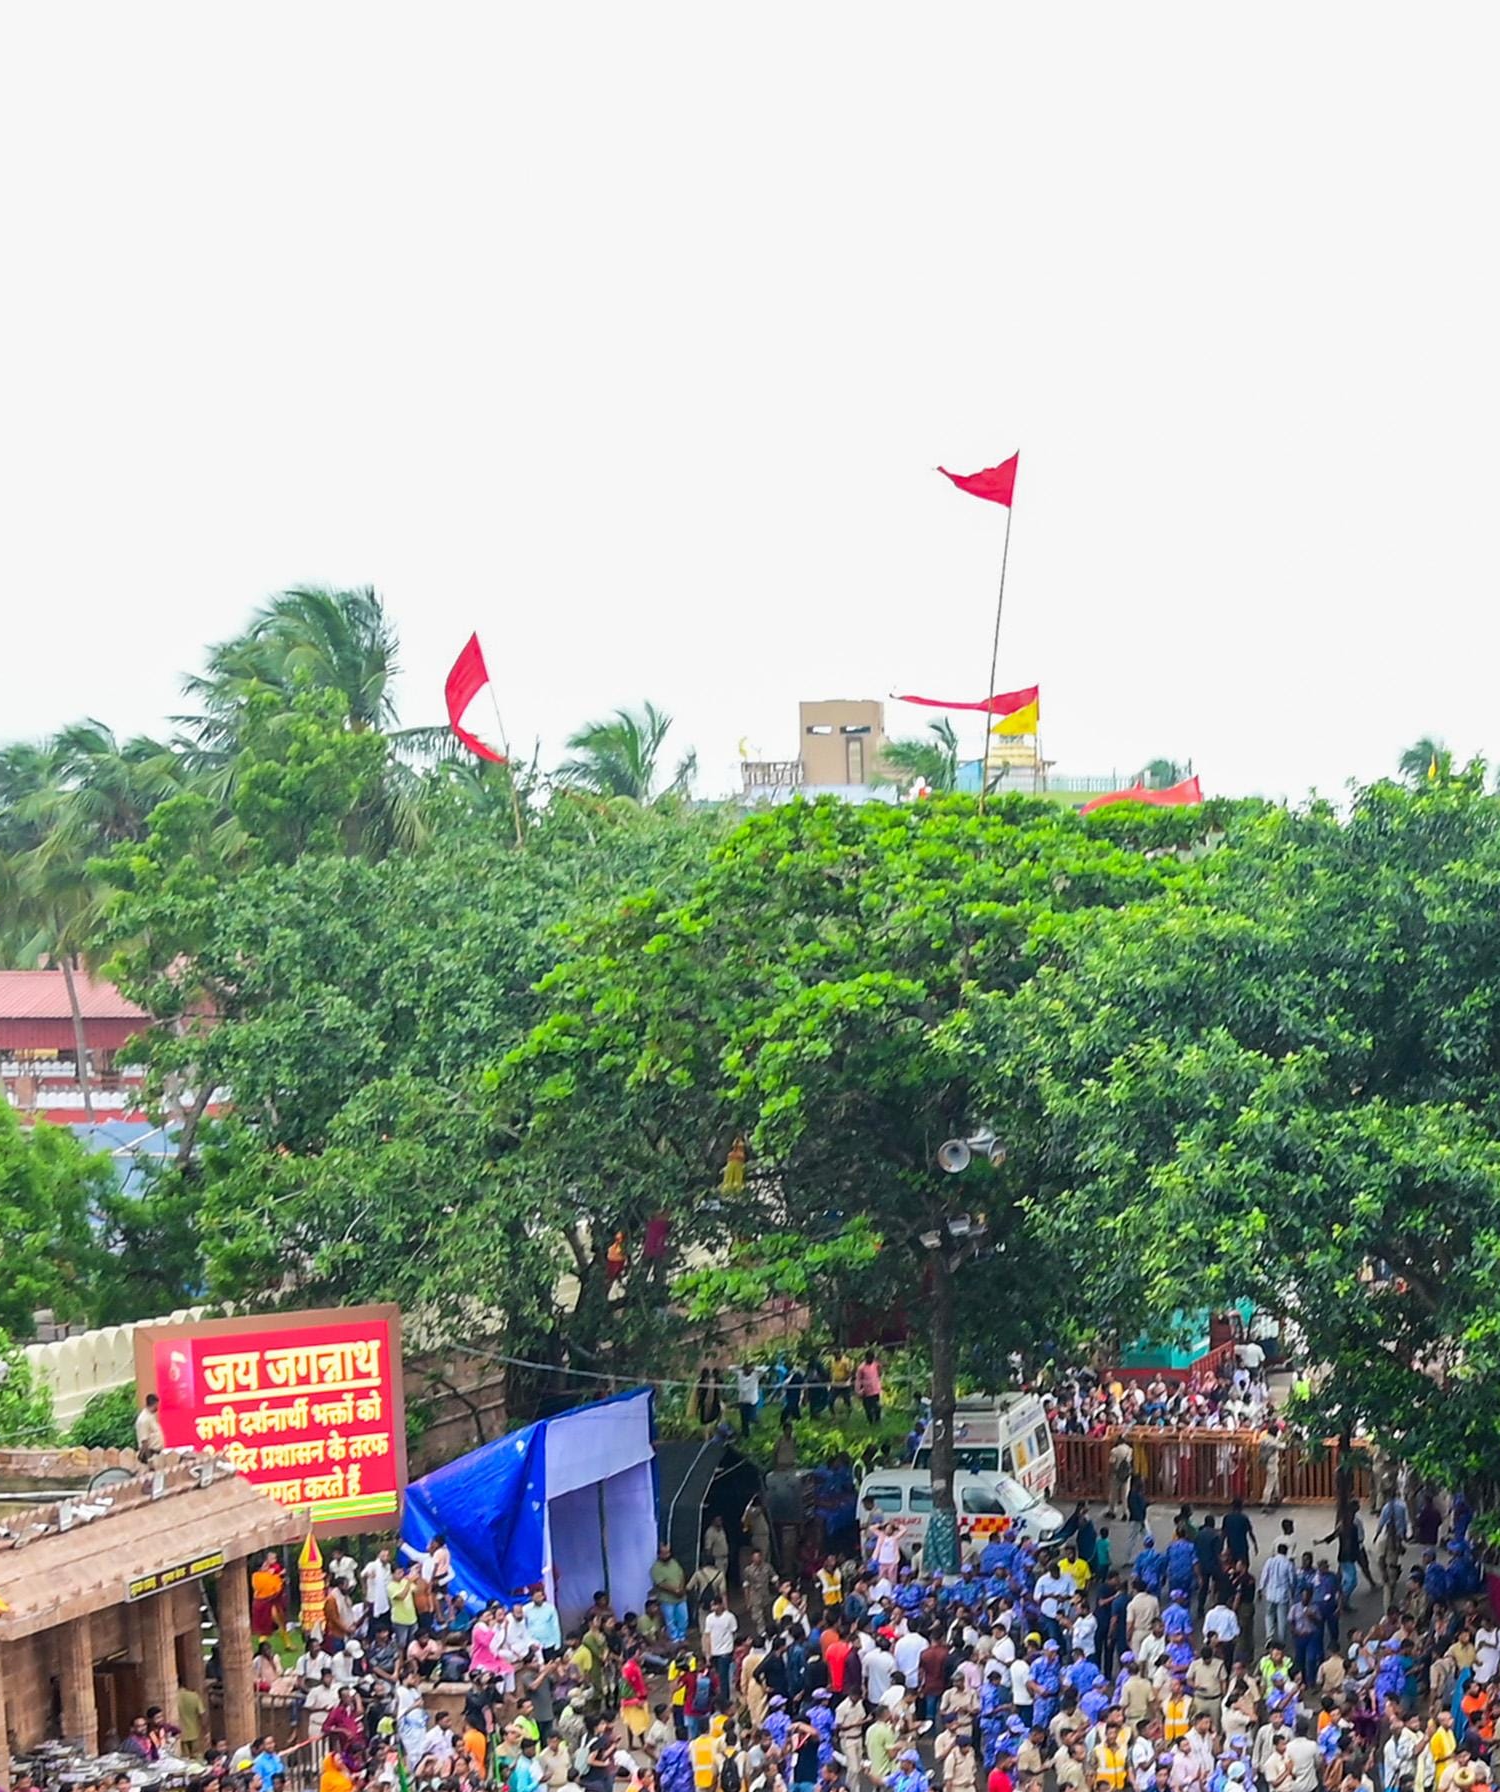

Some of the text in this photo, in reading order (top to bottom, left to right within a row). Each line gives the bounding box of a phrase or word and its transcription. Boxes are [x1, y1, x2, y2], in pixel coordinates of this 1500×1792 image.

[202, 1340, 381, 1393] जय जगन्नाथ
[194, 1405, 237, 1440] सभी
[311, 1393, 355, 1426] भक्तों
[356, 1390, 382, 1422] को
[260, 1440, 325, 1470] प्रशासन
[326, 1430, 348, 1461] के
[348, 1433, 390, 1459] तरफ
[303, 1466, 345, 1499] करते
[346, 1463, 362, 1498] हैं
